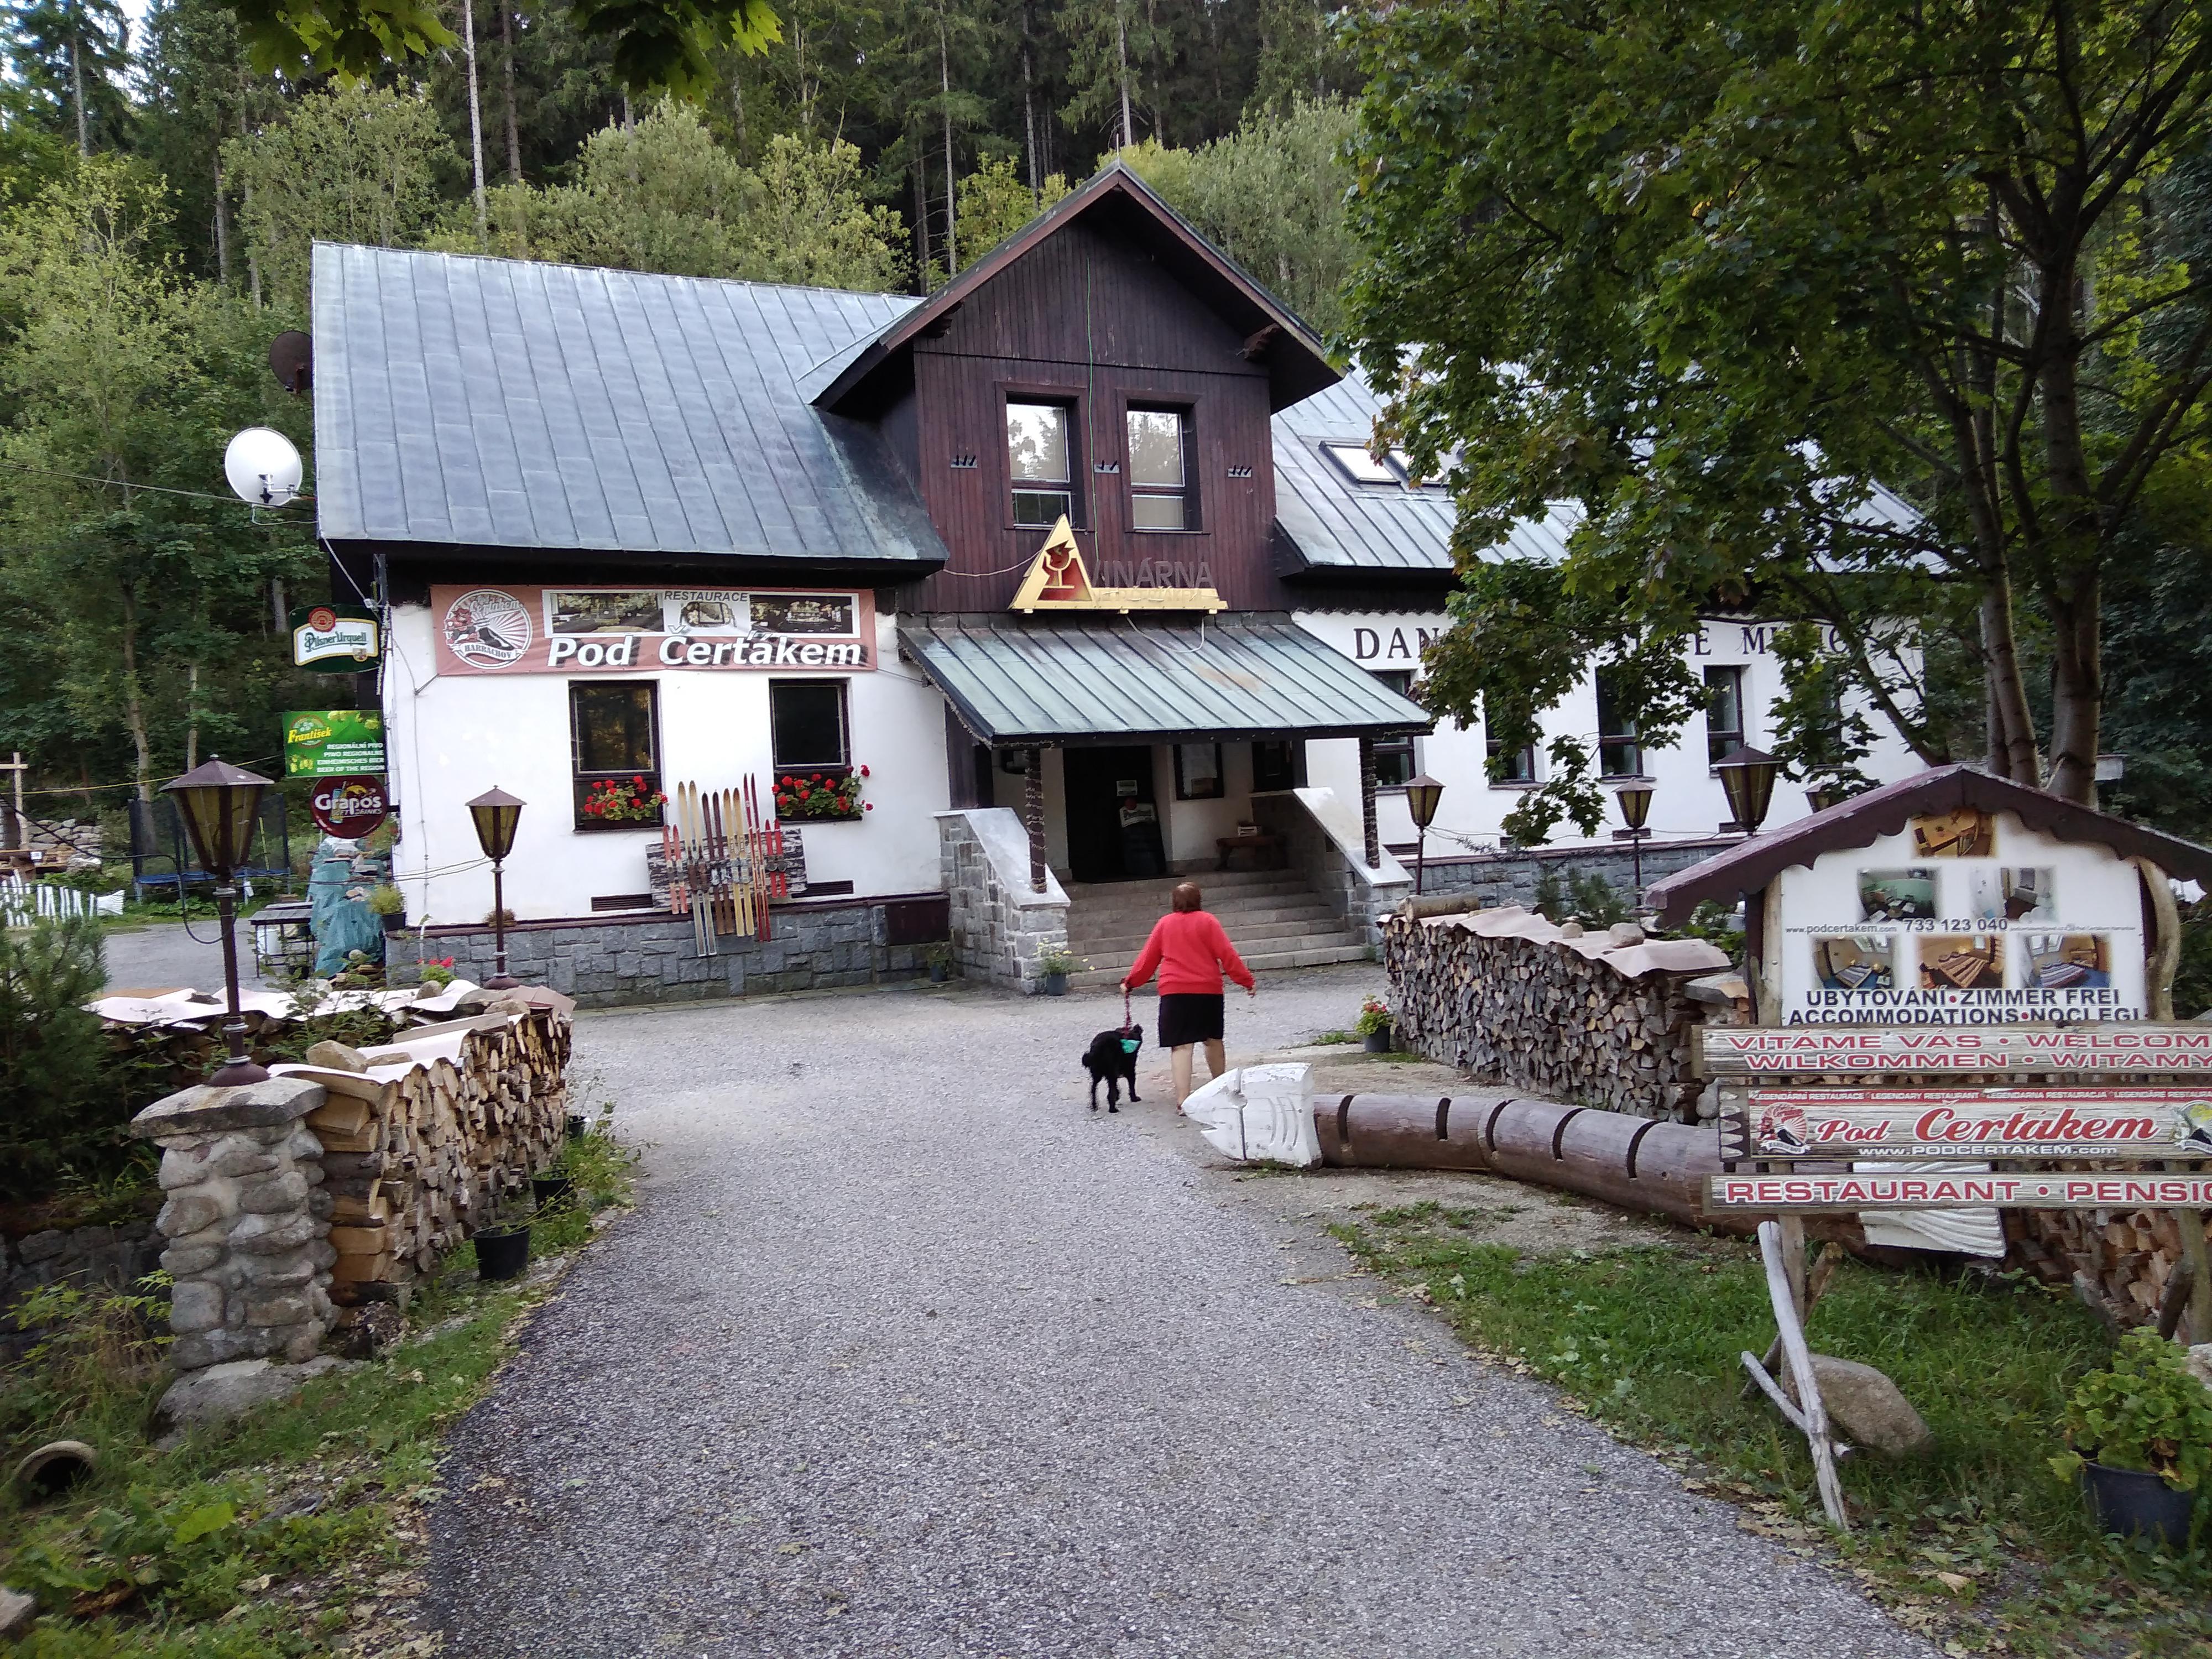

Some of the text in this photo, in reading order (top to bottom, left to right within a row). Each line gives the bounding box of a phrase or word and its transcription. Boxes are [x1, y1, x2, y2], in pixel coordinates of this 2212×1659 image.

[664, 591, 749, 603] RESTAURACE
[305, 630, 367, 653] Pilsner Urquell
[465, 644, 512, 658] HARRACHOV
[547, 635, 634, 667] Pod
[287, 727, 332, 743] František
[1786, 924, 1896, 933] www.podcertakem.com
[1903, 918, 1934, 932] 733
[1941, 918, 1971, 931] 123
[1977, 918, 2007, 931] 040
[1806, 985, 2119, 1006] UBYTOVÁNÍ ZIMMER FREI
[1788, 1007, 2139, 1024] ACCOMMODATIONS NOCLEGI
[1728, 1030, 1881, 1050] VÍTÁME
[1897, 1029, 1983, 1048] VÁS
[1745, 1052, 2212, 1070] WILKOMMEN WITAMY
[1816, 1119, 1891, 1142] Pod
[1858, 1145, 2117, 1155] www.PODCERTAKEM.com
[1725, 1180, 2021, 1203] RESTAURANT
